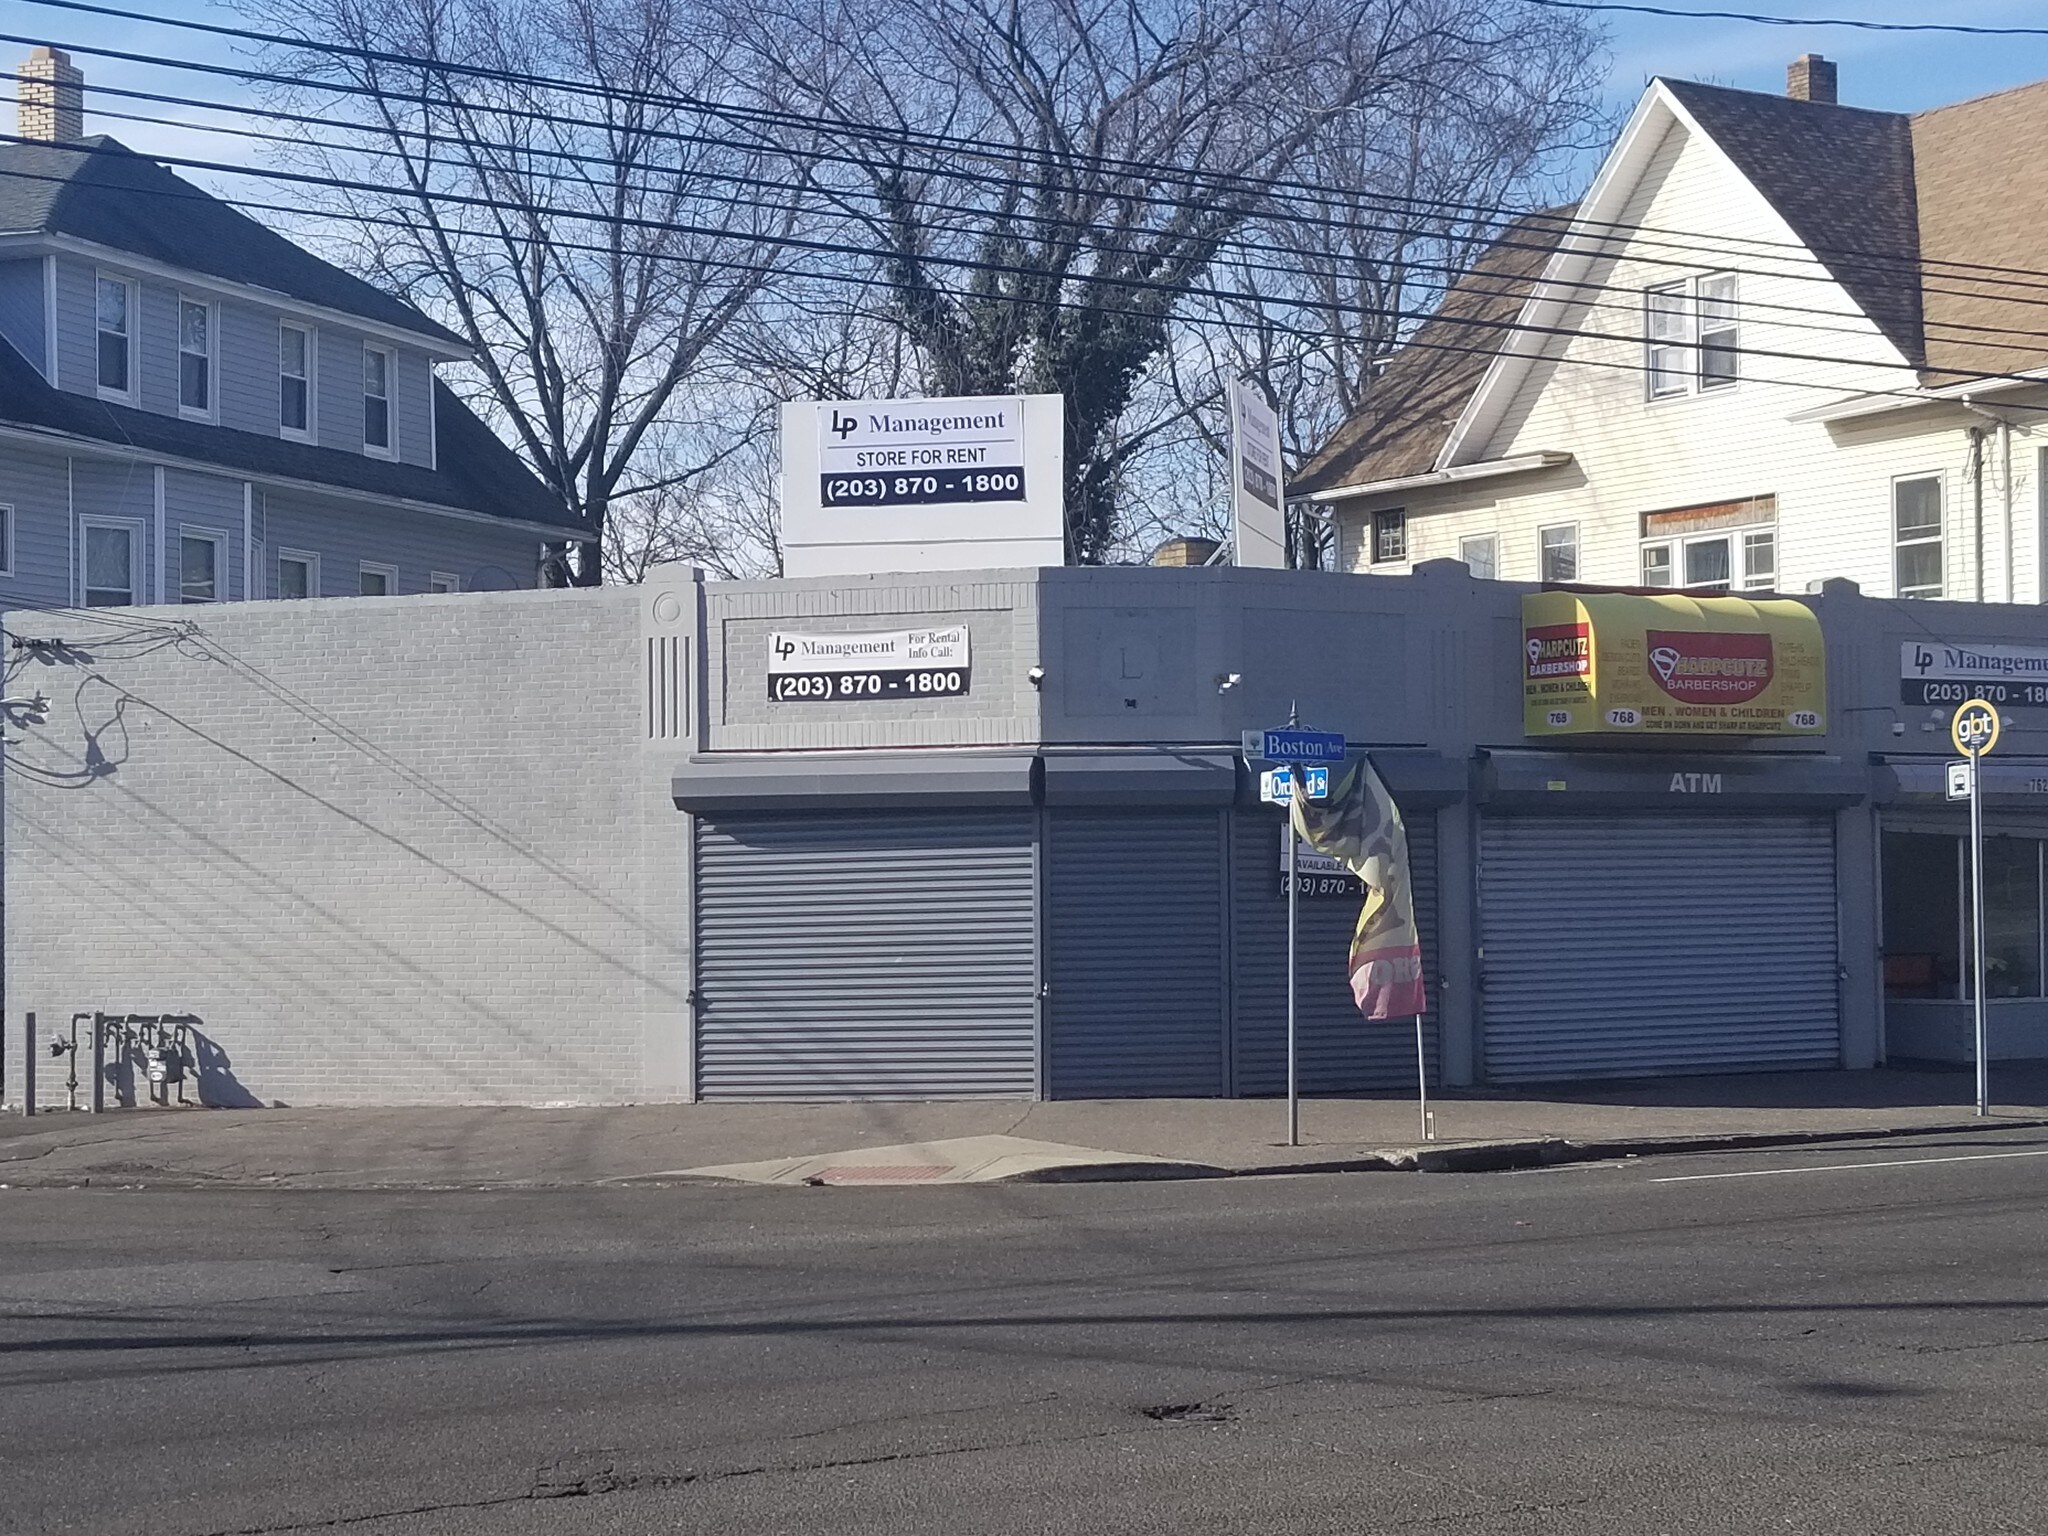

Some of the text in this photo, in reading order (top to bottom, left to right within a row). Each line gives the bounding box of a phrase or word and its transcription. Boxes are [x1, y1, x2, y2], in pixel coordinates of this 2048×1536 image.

[832, 410, 1005, 439] LP Management
[857, 448, 986, 467] STORE FOR RENT
[826, 479, 886, 501] (203)
[894, 477, 938, 494] 870
[962, 474, 1019, 492] 1800
[775, 636, 895, 661] LP Management
[908, 632, 960, 644] For Rental
[908, 646, 953, 659] Info Call:
[1527, 637, 1588, 664] SHARPCUTZ
[1915, 645, 1933, 675] LP
[1530, 660, 1588, 676] BARBERSHOP
[1650, 648, 1768, 681] SHARPCUTZ
[775, 676, 833, 701] (203)
[840, 674, 882, 694] 870
[905, 672, 961, 692] 1800
[1667, 680, 1756, 691] BARBERSHOP
[1923, 683, 1968, 704] (203)
[1974, 686, 2006, 702] 870
[2025, 686, 2048, 702] 18
[1550, 712, 1567, 724] 768
[1612, 711, 1634, 724] 768
[1642, 706, 1666, 716] MEN
[1674, 706, 1716, 717] WOMEN
[1720, 707, 1728, 717] &
[1731, 708, 1784, 718] CHILDREN
[1794, 714, 1816, 726] 768
[1958, 712, 1992, 742] gbt
[1268, 735, 1323, 756] Boston
[1326, 742, 1342, 754] Ave
[1670, 773, 1722, 794] ATM
[1281, 876, 1316, 896] (23)
[1320, 879, 1346, 894] 870
